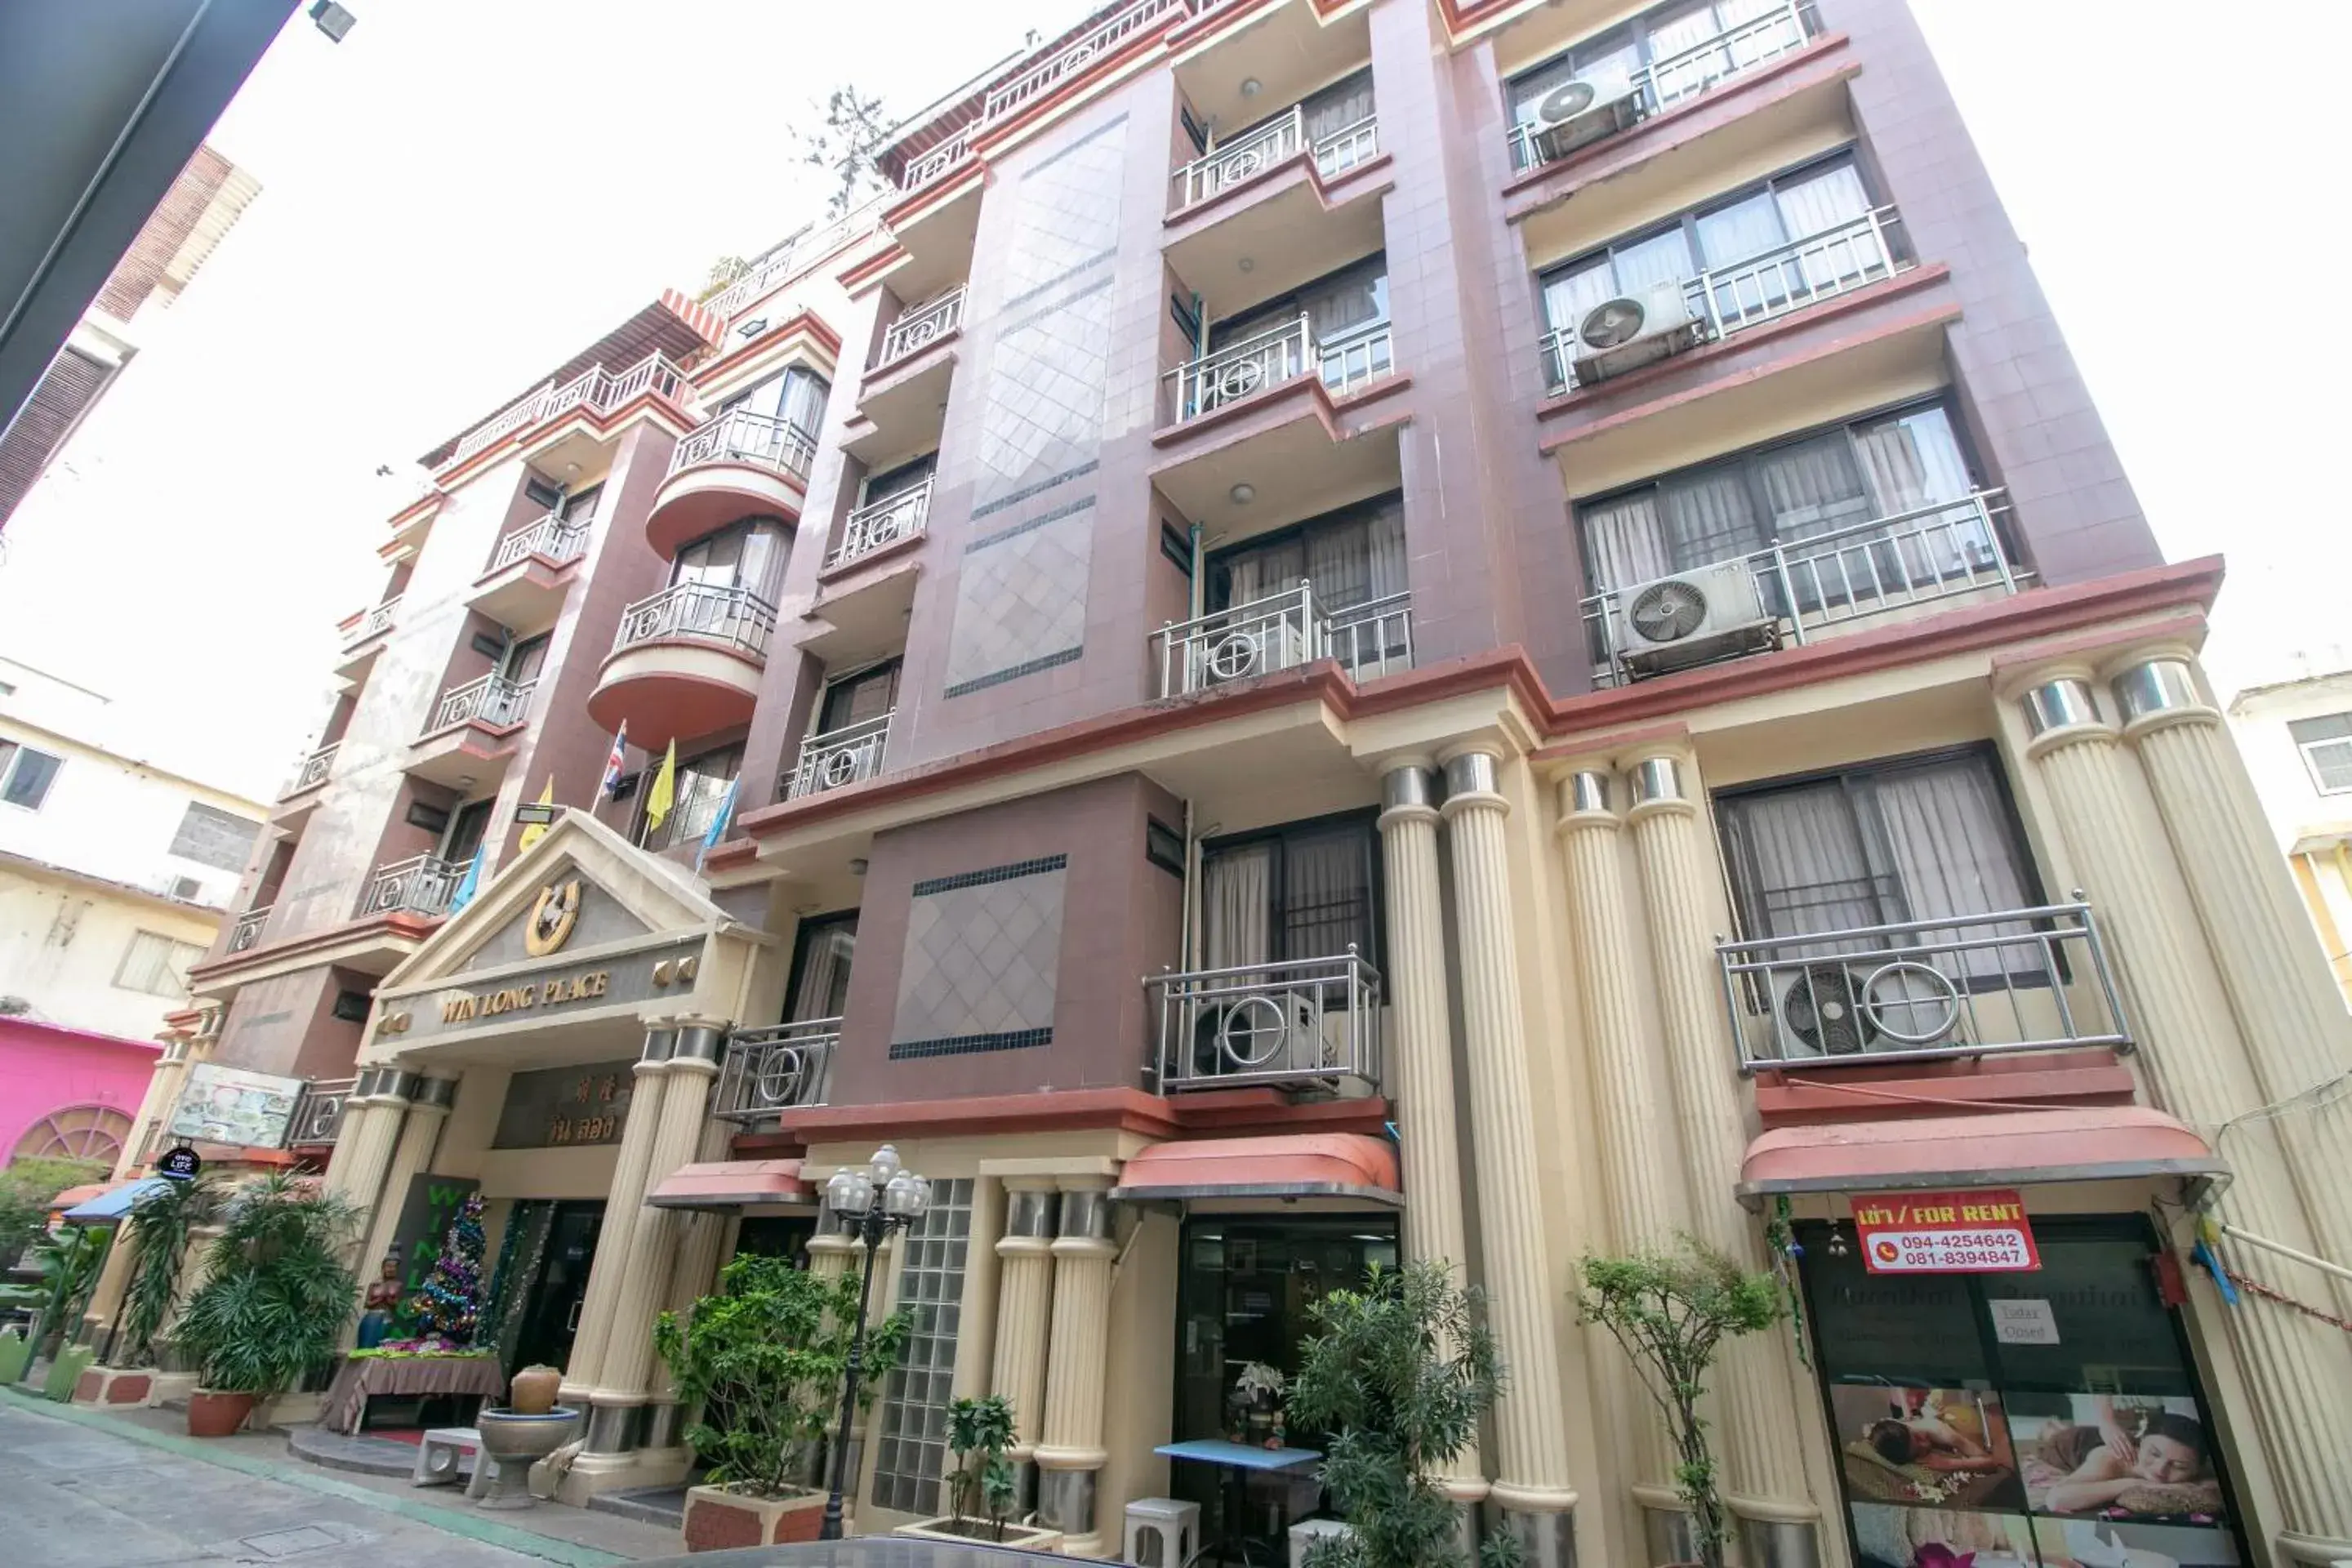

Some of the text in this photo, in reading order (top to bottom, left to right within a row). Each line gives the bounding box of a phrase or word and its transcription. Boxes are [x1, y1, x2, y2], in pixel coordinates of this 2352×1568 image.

[442, 970, 608, 1022] WIN LONG PLACE
[1912, 1205, 1957, 1223] FOR
[1962, 1204, 2020, 1222] RENT
[1901, 1233, 2017, 1250] 094-4254642
[1906, 1250, 2020, 1266] 081-8394847
